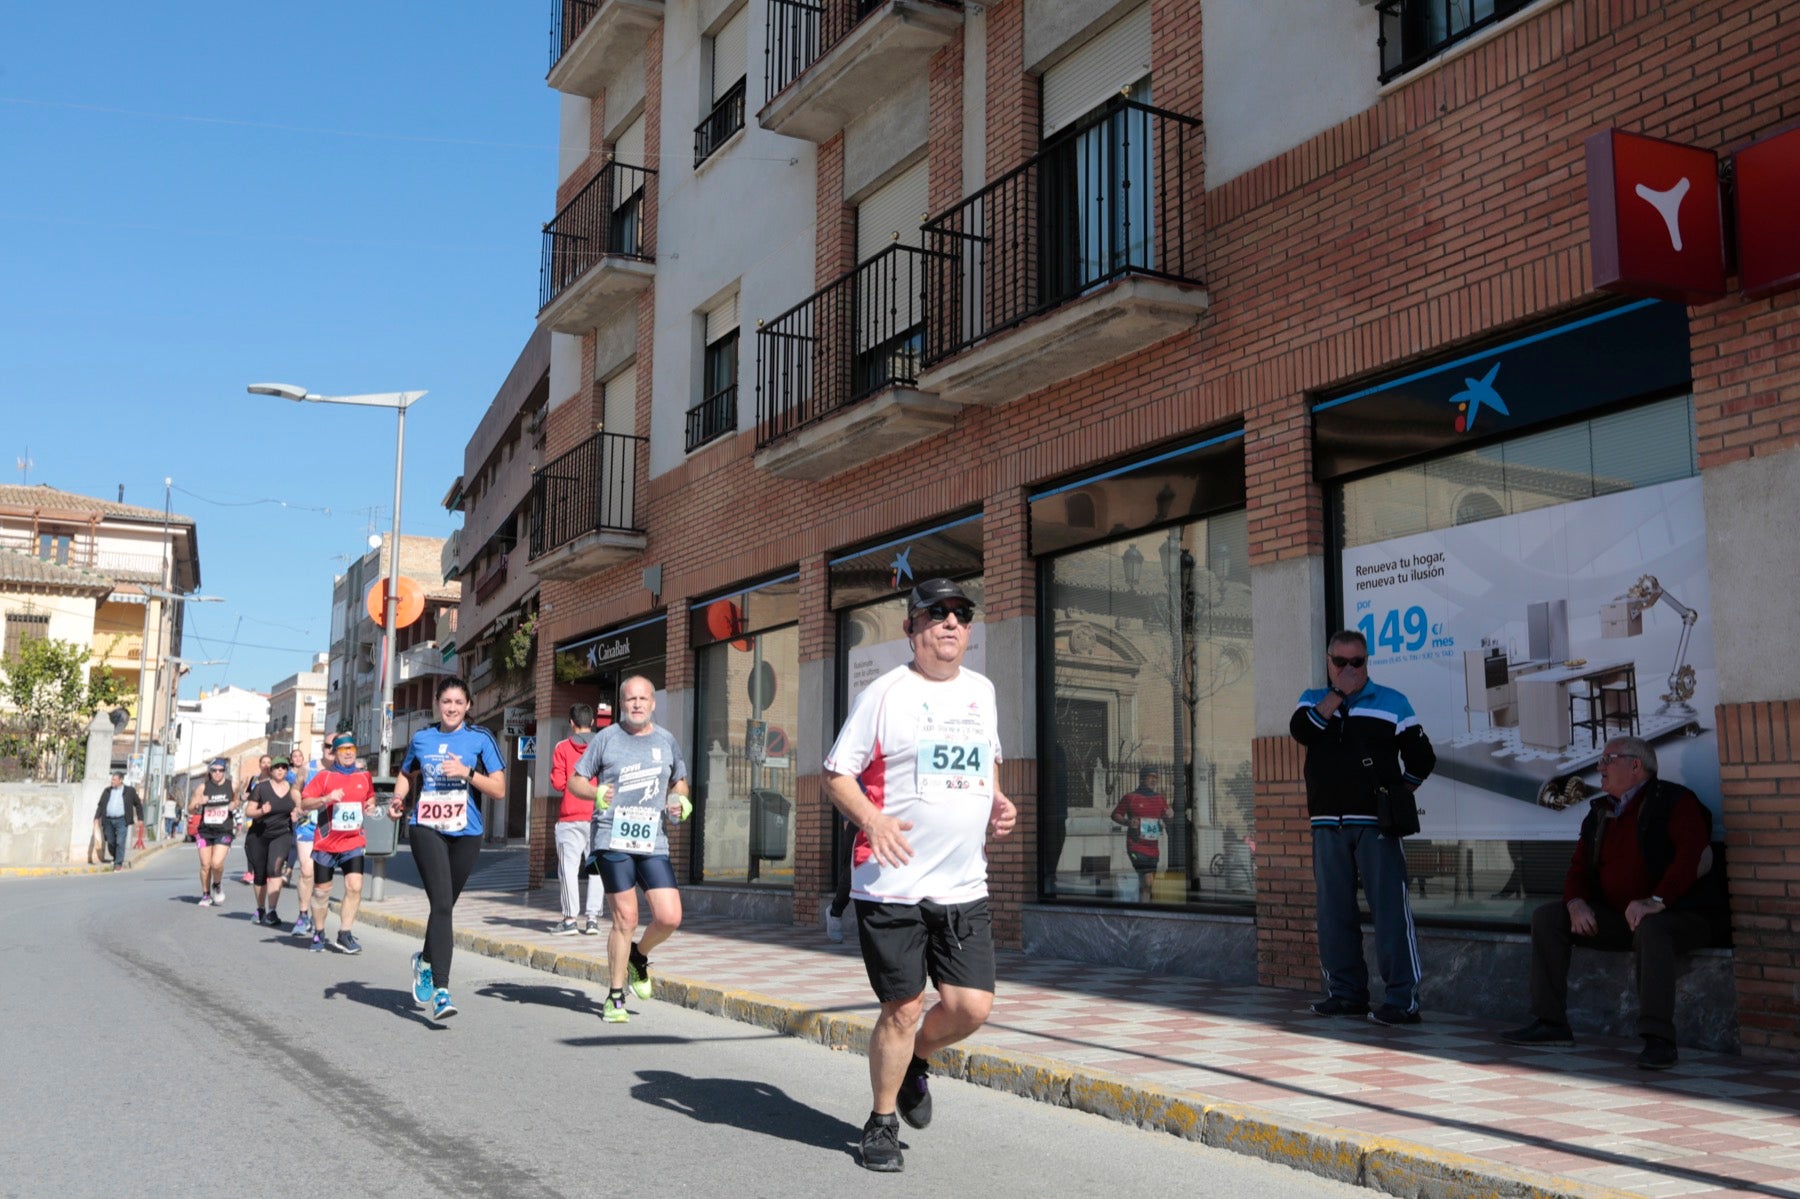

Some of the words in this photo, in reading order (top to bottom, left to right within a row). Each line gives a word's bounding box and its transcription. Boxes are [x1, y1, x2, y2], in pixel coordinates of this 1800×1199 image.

[1356, 561, 1398, 577] Renueva
[1400, 558, 1411, 569] tu
[1413, 552, 1446, 569] hogar,
[1356, 575, 1395, 591] renueva
[1398, 573, 1408, 584] tu
[1411, 566, 1445, 582] ilusión
[1356, 600, 1372, 612] por
[1357, 605, 1428, 657] 149
[598, 637, 631, 661] CaixaBank
[1432, 637, 1454, 648] mes
[932, 744, 981, 772] 524
[342, 811, 356, 822] 64
[421, 803, 464, 820] 2037
[620, 821, 651, 839] 986
